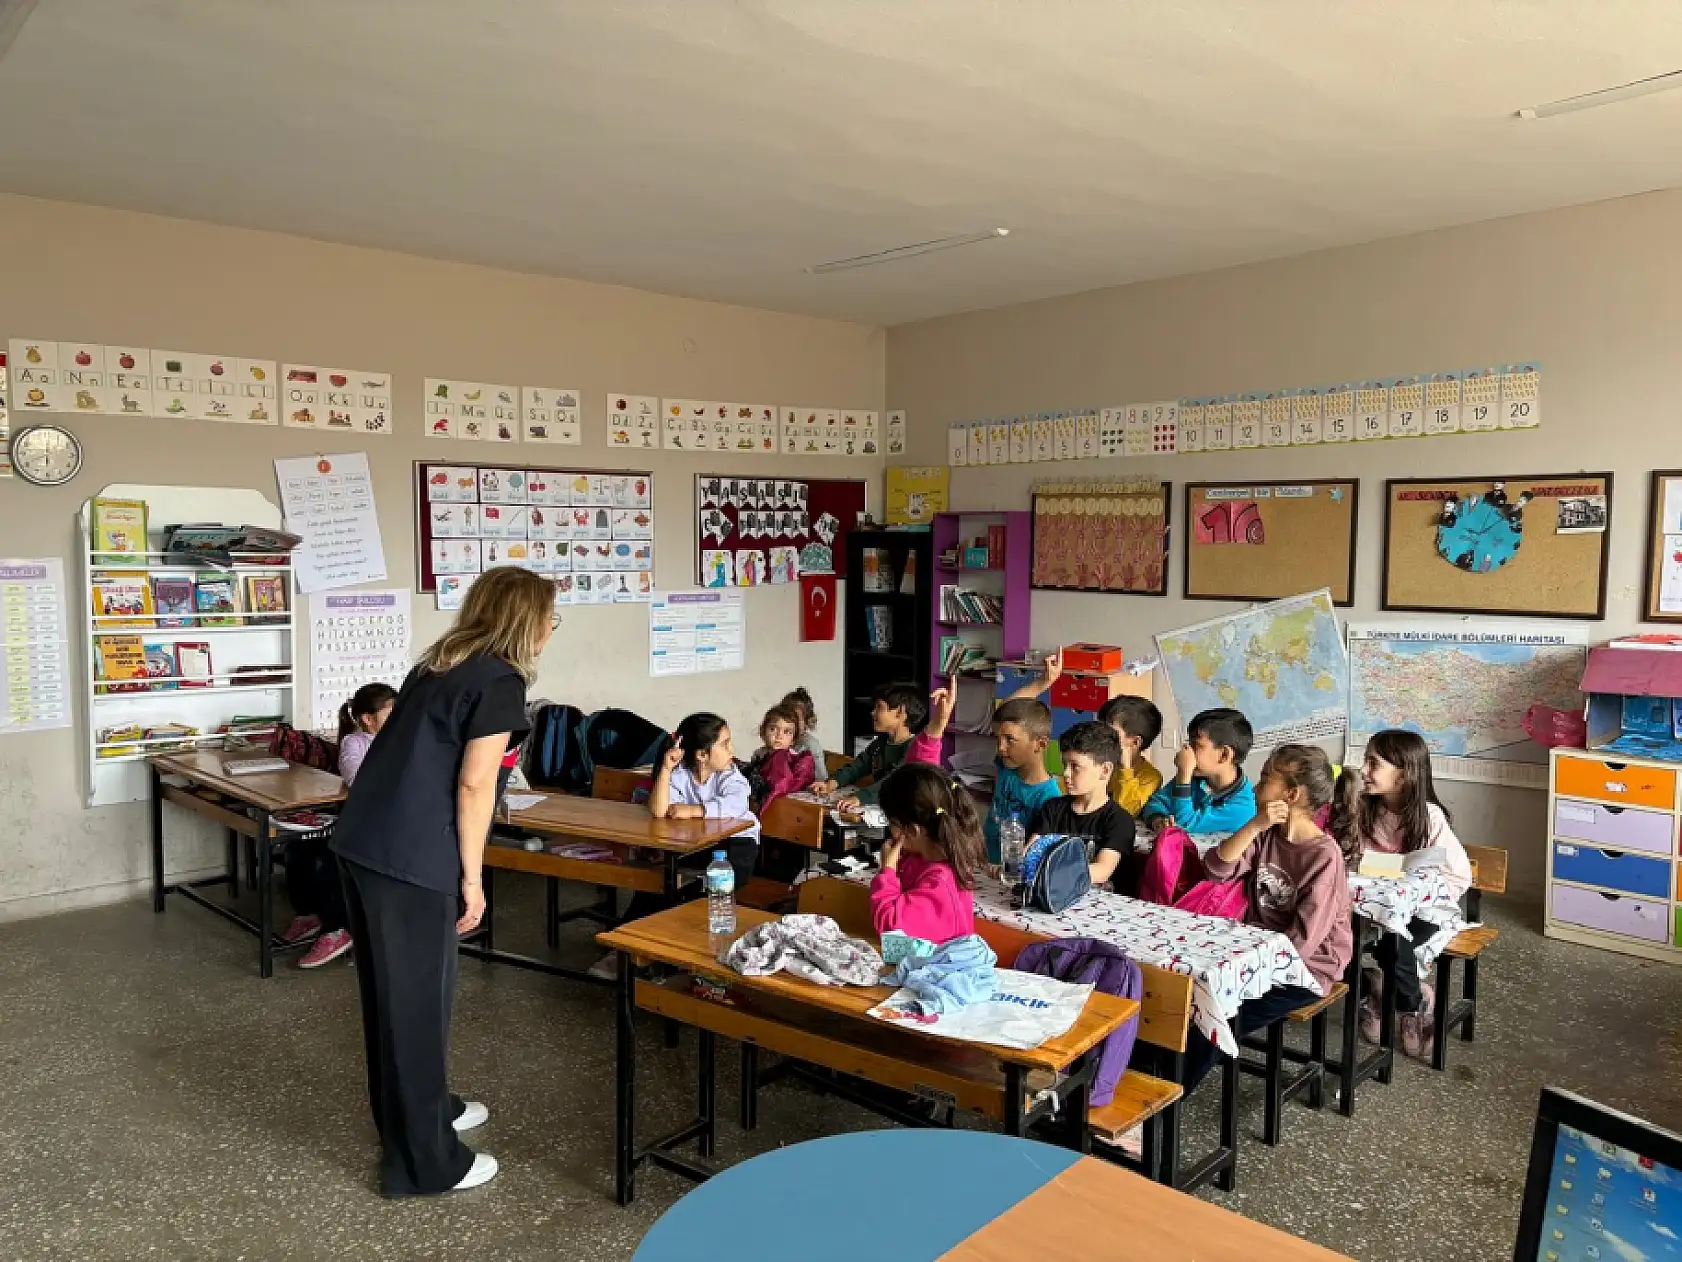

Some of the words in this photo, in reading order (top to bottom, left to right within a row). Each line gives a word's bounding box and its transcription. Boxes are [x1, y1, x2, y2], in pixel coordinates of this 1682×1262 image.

[1434, 409, 1448, 423] 18
[1472, 406, 1488, 420] 19
[1510, 402, 1530, 418] 20
[1332, 419, 1344, 432] 15
[1365, 415, 1378, 429] 16
[1400, 412, 1412, 426] 17
[1215, 428, 1223, 440] 11
[1241, 425, 1252, 438] 12
[1300, 423, 1314, 434] 14
[1185, 429, 1197, 442] 10
